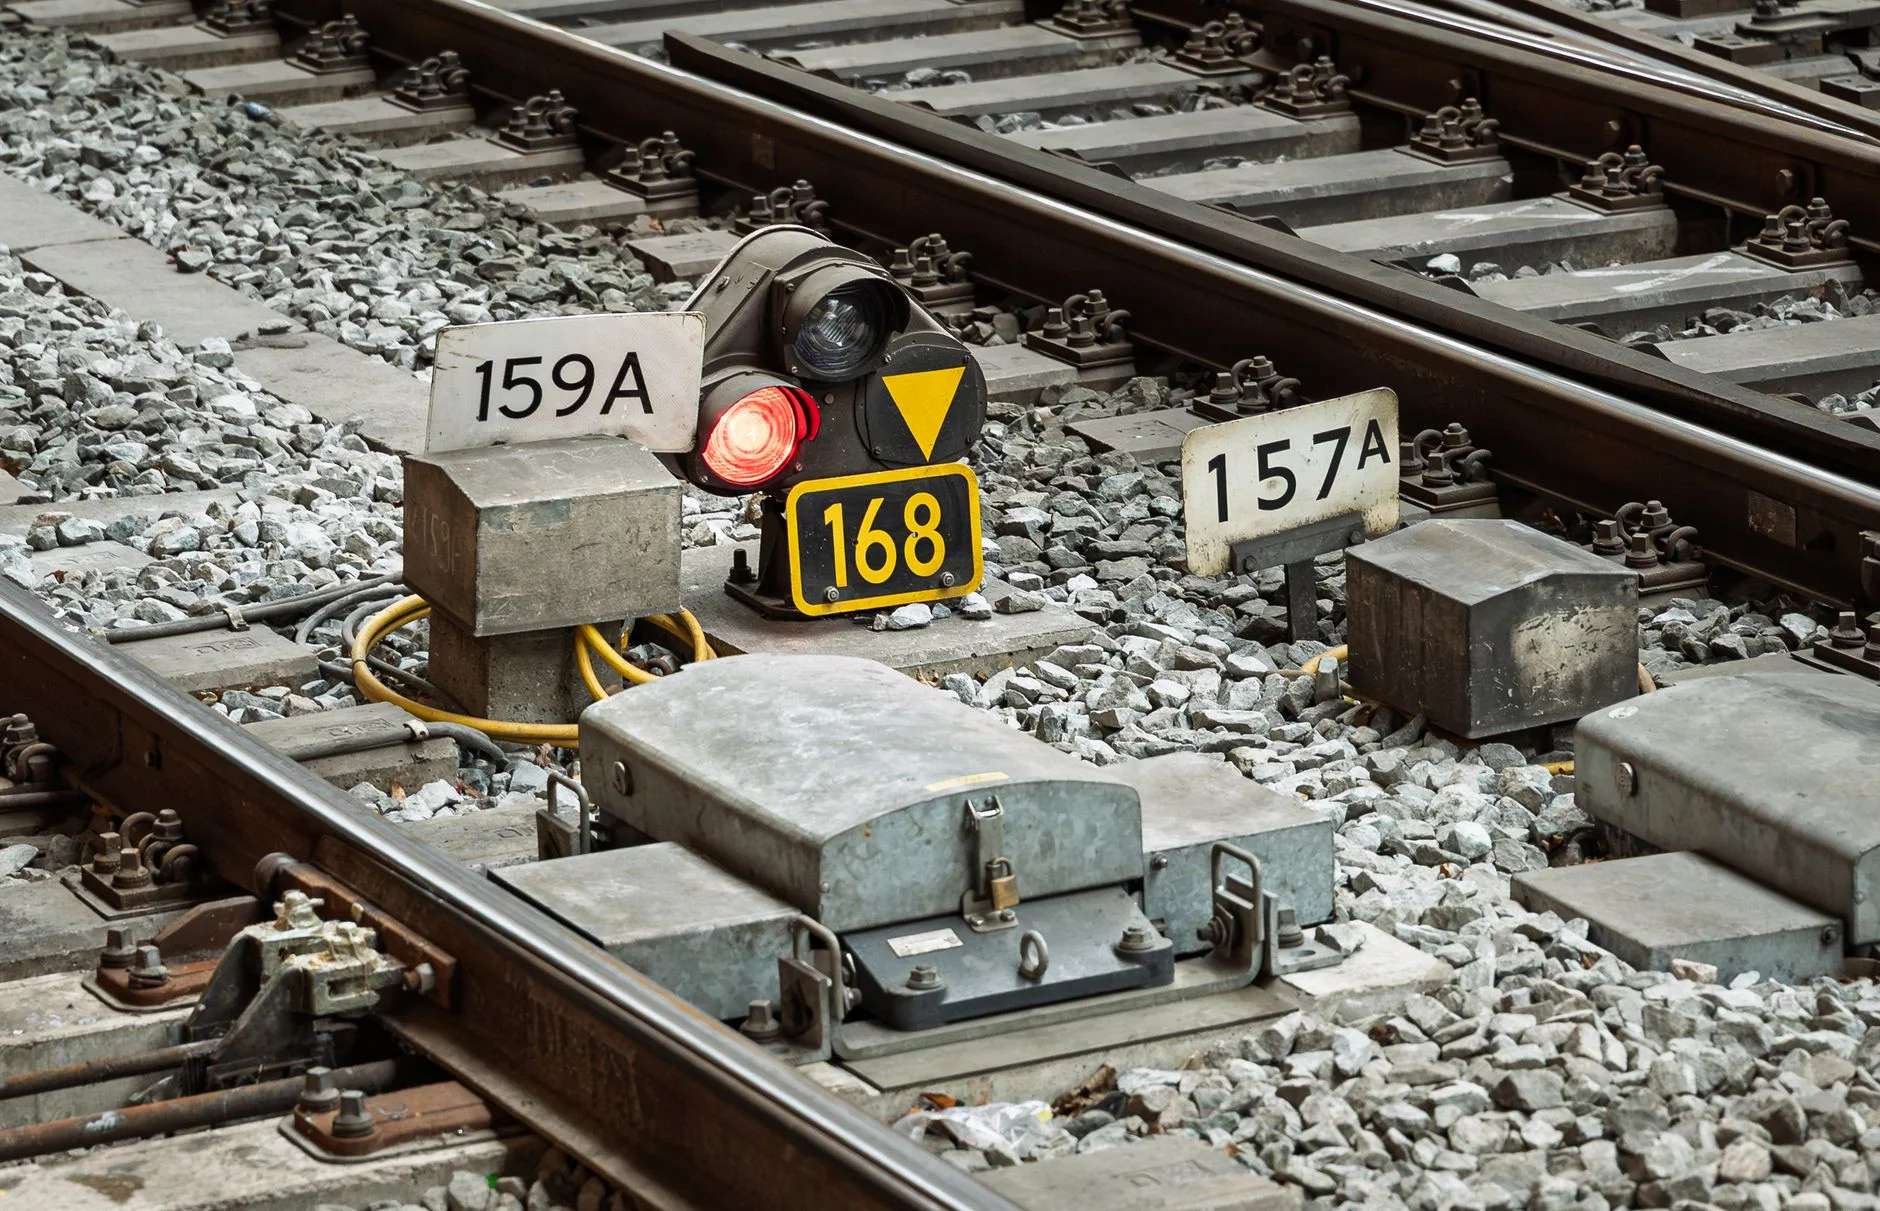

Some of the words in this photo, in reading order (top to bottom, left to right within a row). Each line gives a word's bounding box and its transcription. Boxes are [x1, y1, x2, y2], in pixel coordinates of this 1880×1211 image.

[475, 351, 653, 422] 159A
[1208, 418, 1391, 522] 157A
[824, 492, 946, 587] 168
